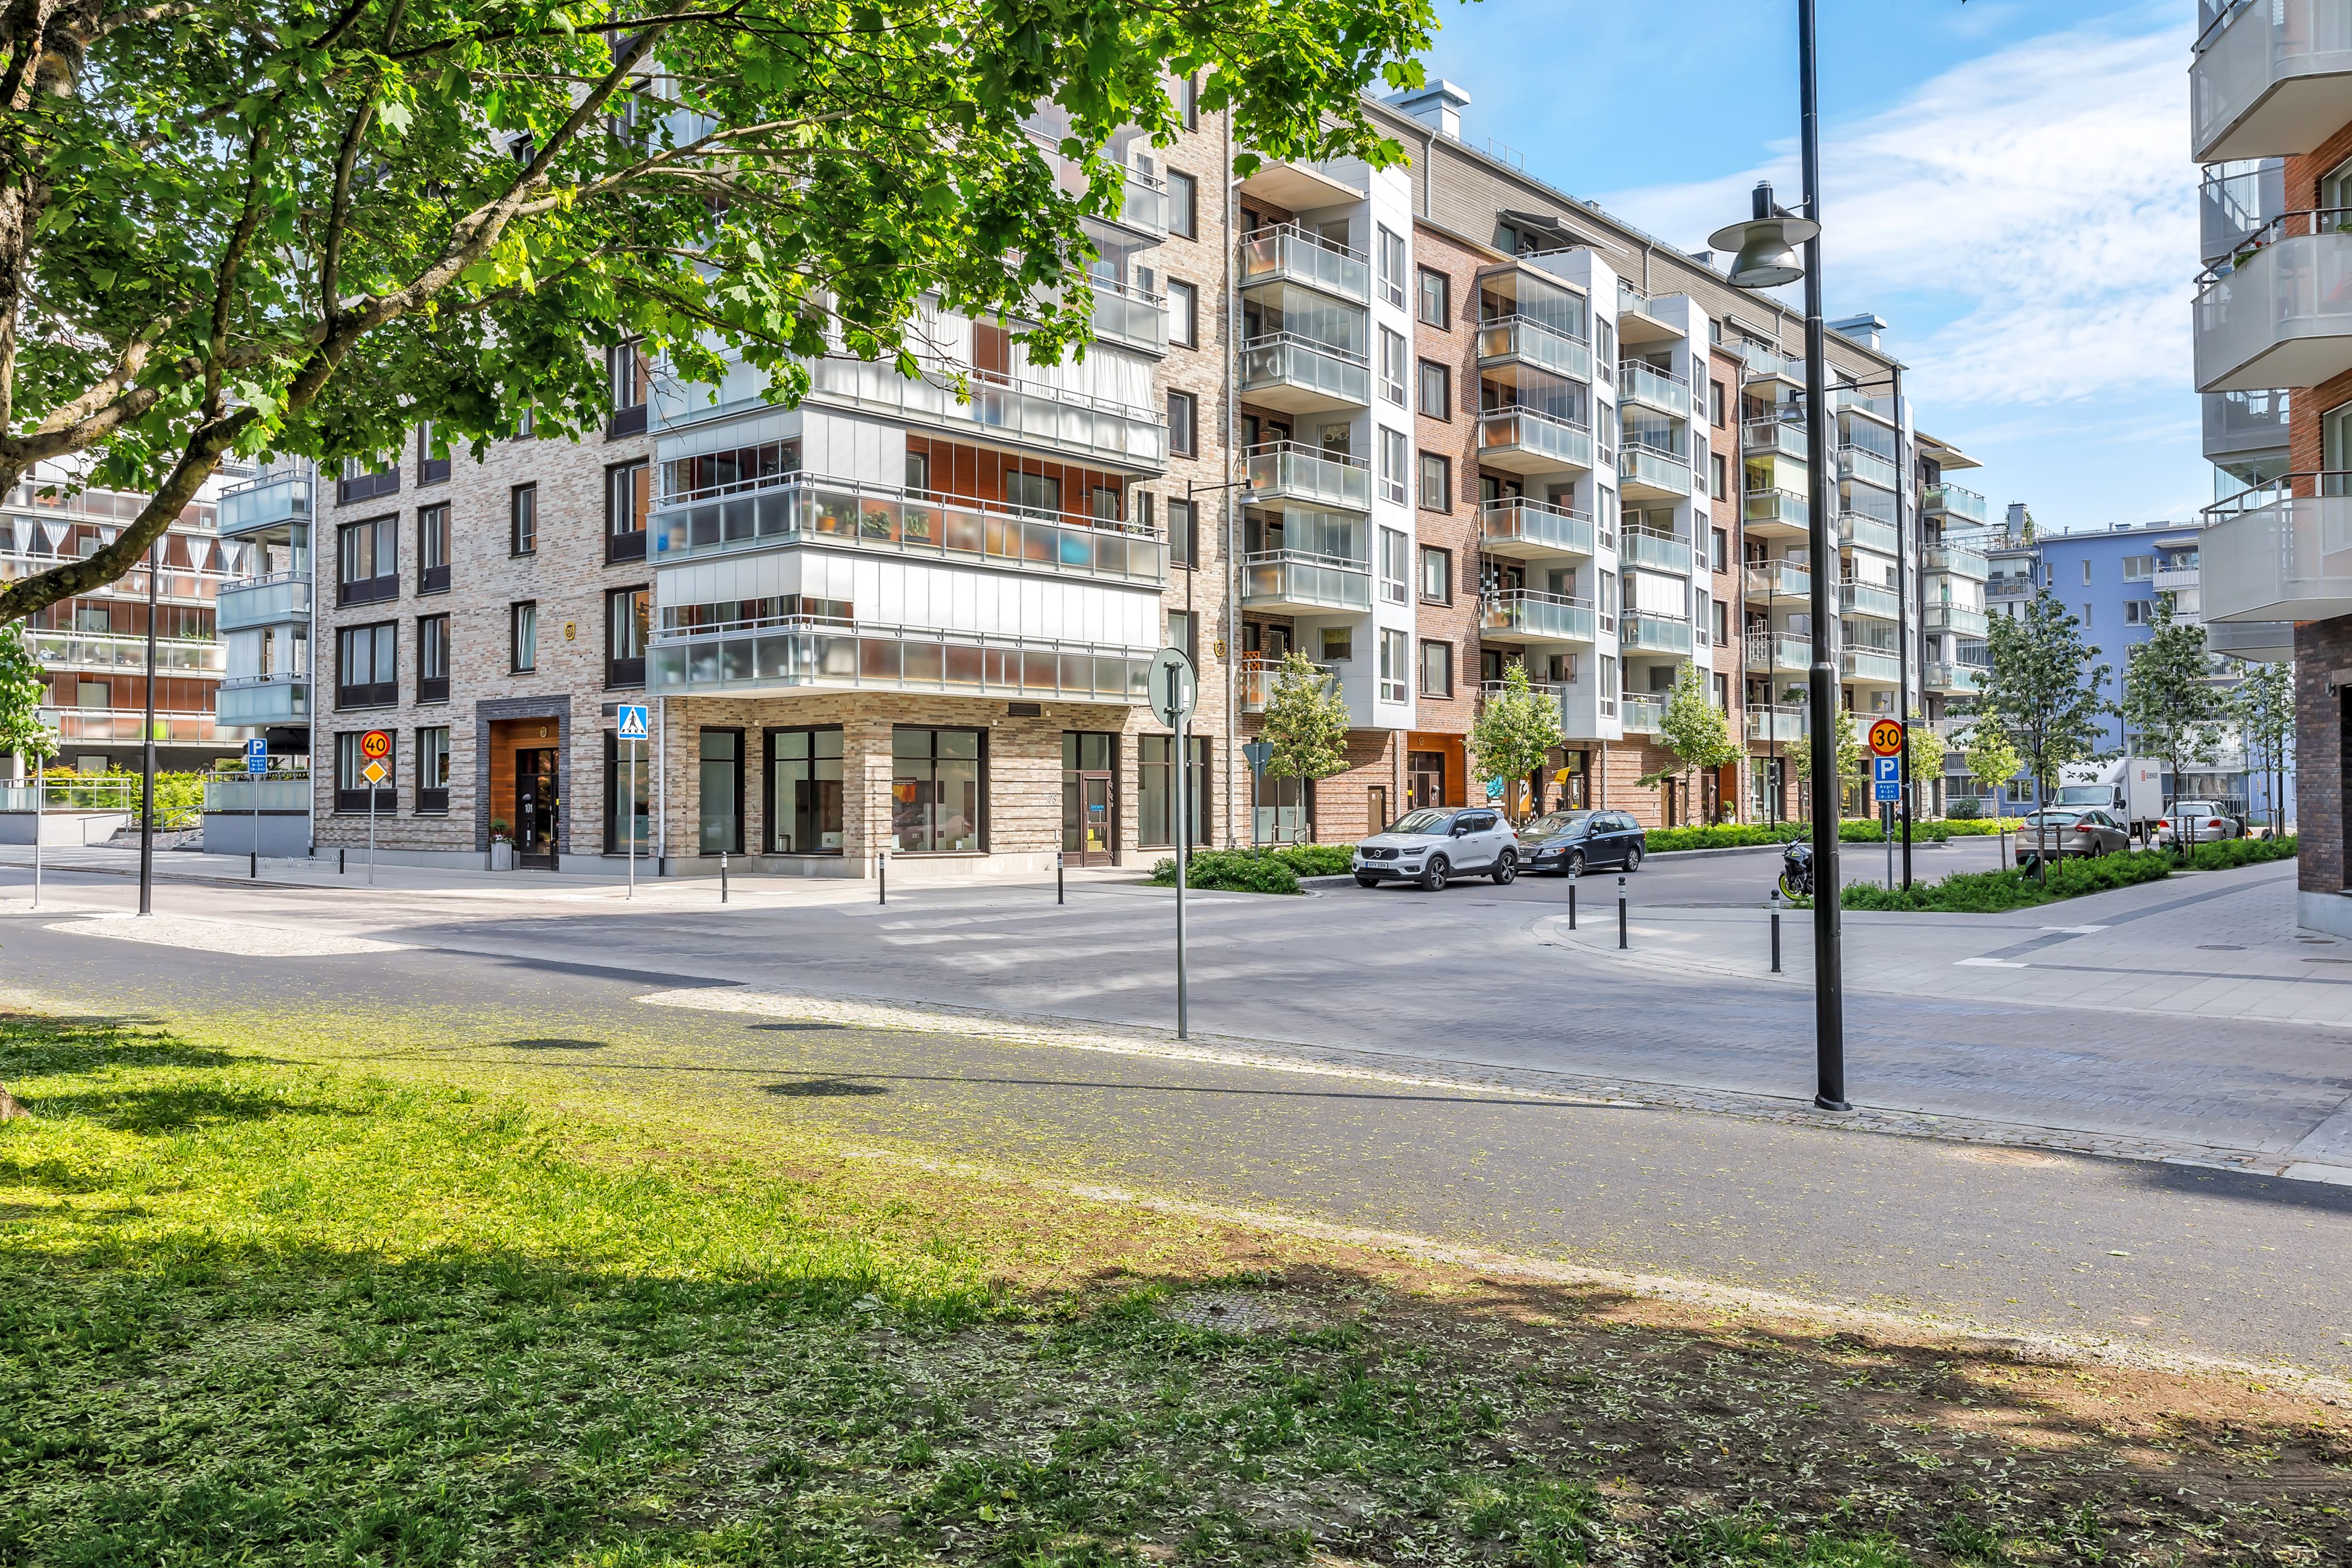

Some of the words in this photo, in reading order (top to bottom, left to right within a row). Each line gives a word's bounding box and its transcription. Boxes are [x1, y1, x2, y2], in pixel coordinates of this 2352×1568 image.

[366, 738, 385, 752] 40
[1875, 729, 1899, 747] 30
[253, 740, 264, 754] P
[1881, 759, 1895, 779] P
[1048, 794, 1057, 804] 23
[1432, 791, 1437, 800] 21
